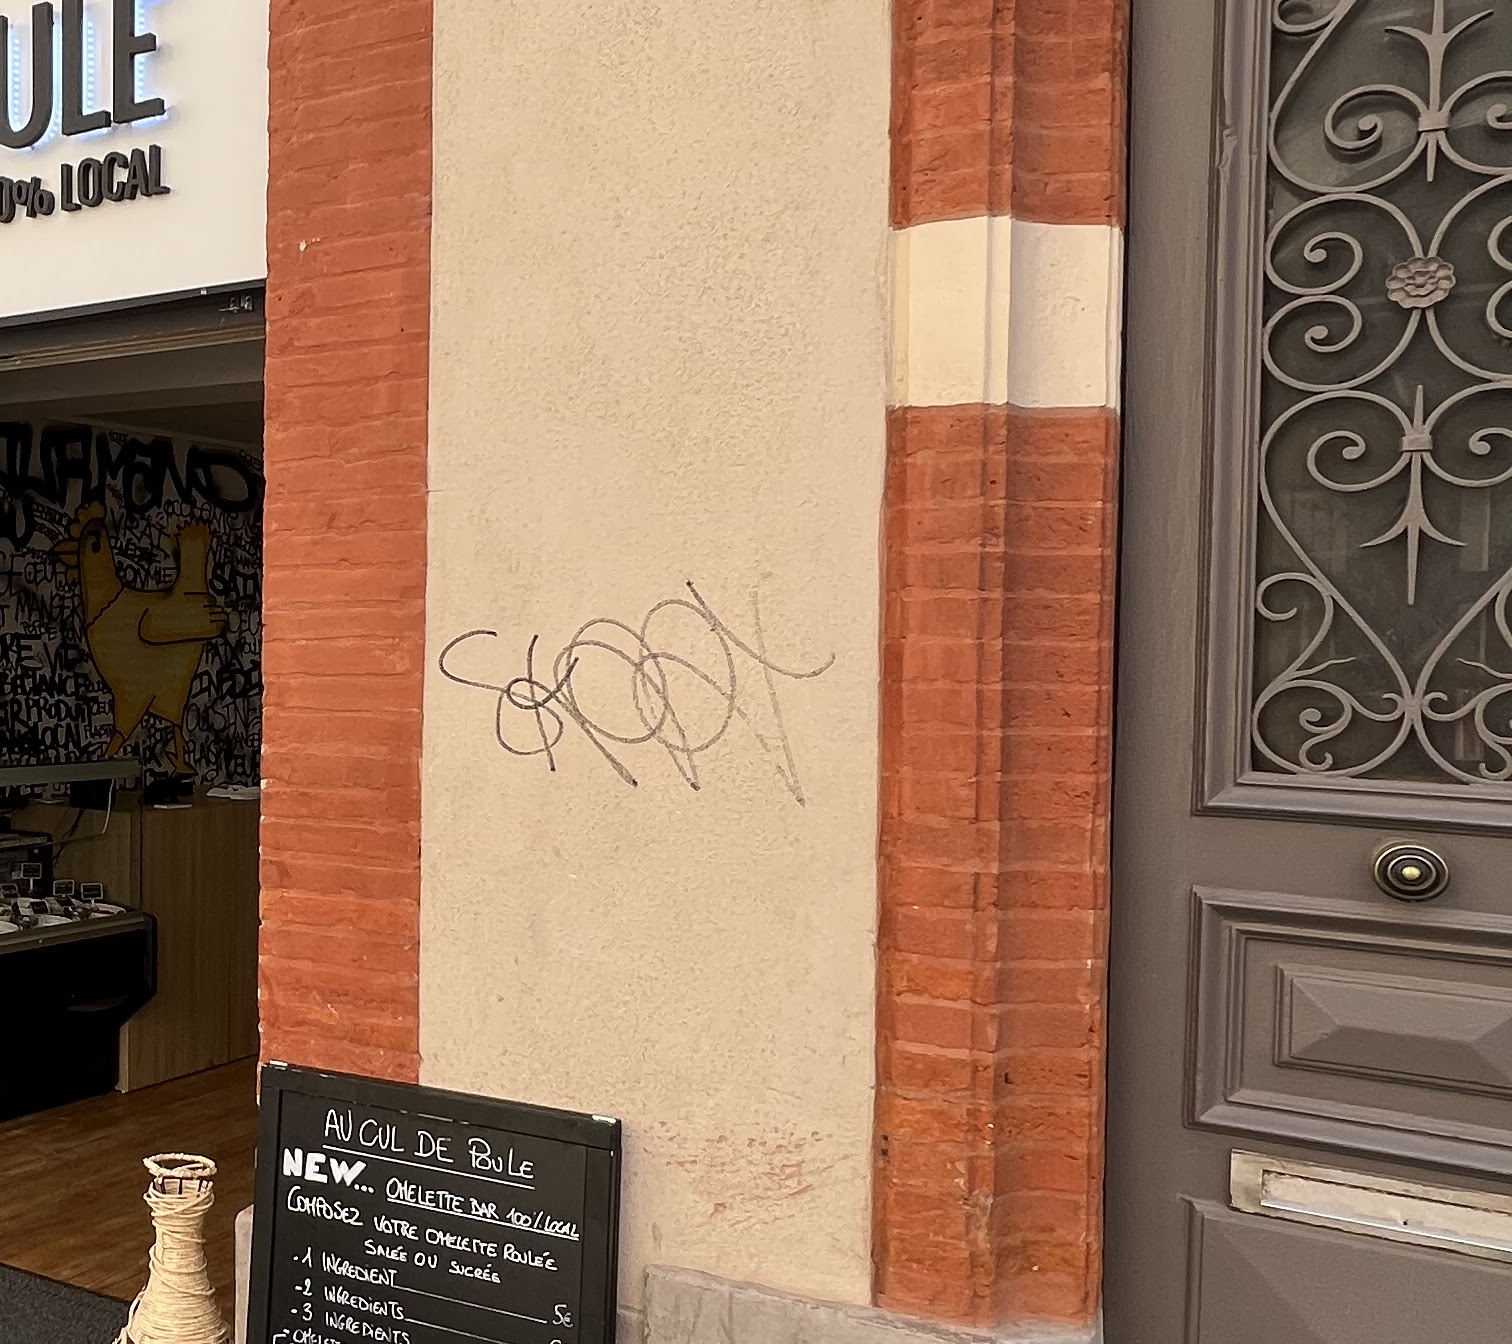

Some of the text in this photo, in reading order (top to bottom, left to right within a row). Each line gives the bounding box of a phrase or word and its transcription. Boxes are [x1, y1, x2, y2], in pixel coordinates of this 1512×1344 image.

[60, 144, 170, 213] LOCAL
[324, 1109, 352, 1143] AU
[359, 1119, 404, 1154] CUL
[414, 1131, 453, 1163] DE
[287, 1186, 363, 1226] COMPOSEZ
[373, 1216, 419, 1241] VOTRE
[425, 1229, 497, 1258] OMELETTE
[386, 1179, 464, 1213] OMELETTE
[469, 1197, 499, 1222] BAR
[364, 1239, 501, 1284] SALÉE OU SUCRÉE
[552, 1304, 574, 1328] 5€
